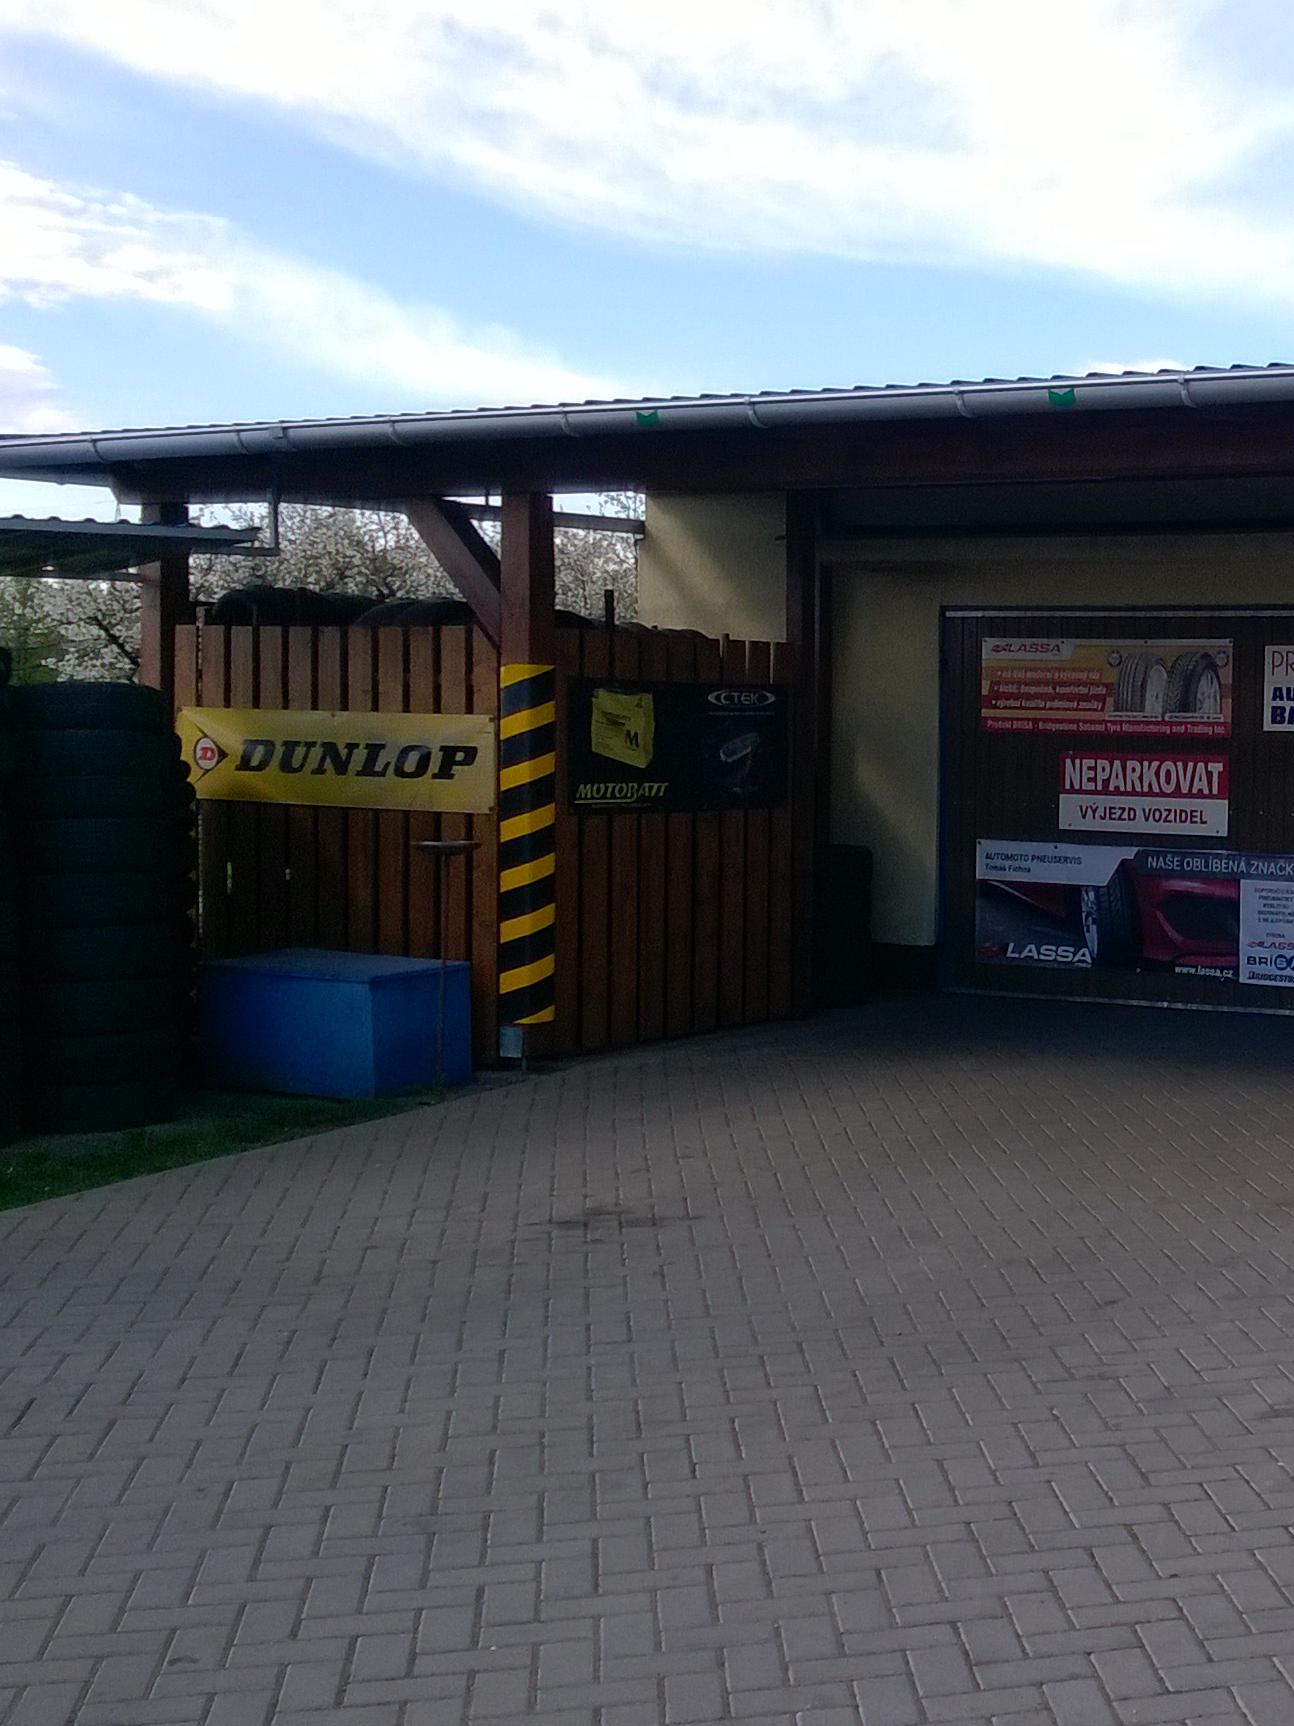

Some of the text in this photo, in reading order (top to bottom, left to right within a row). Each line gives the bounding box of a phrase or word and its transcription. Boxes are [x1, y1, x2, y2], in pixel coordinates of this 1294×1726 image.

[1009, 643, 1061, 653] LASSA
[719, 691, 763, 705] CTEK
[234, 739, 478, 780] DUNLOP
[1064, 757, 1223, 795] NEPARKOVAT
[575, 782, 669, 801] MOTOBATT
[1079, 802, 1207, 824] VÝJEZD VOZIDEL
[1031, 854, 1083, 866] PNEUSERVIS
[1147, 854, 1181, 870] NAŠE
[1183, 856, 1247, 874] OBLÍBENÁ
[1006, 942, 1092, 964] LASSA
